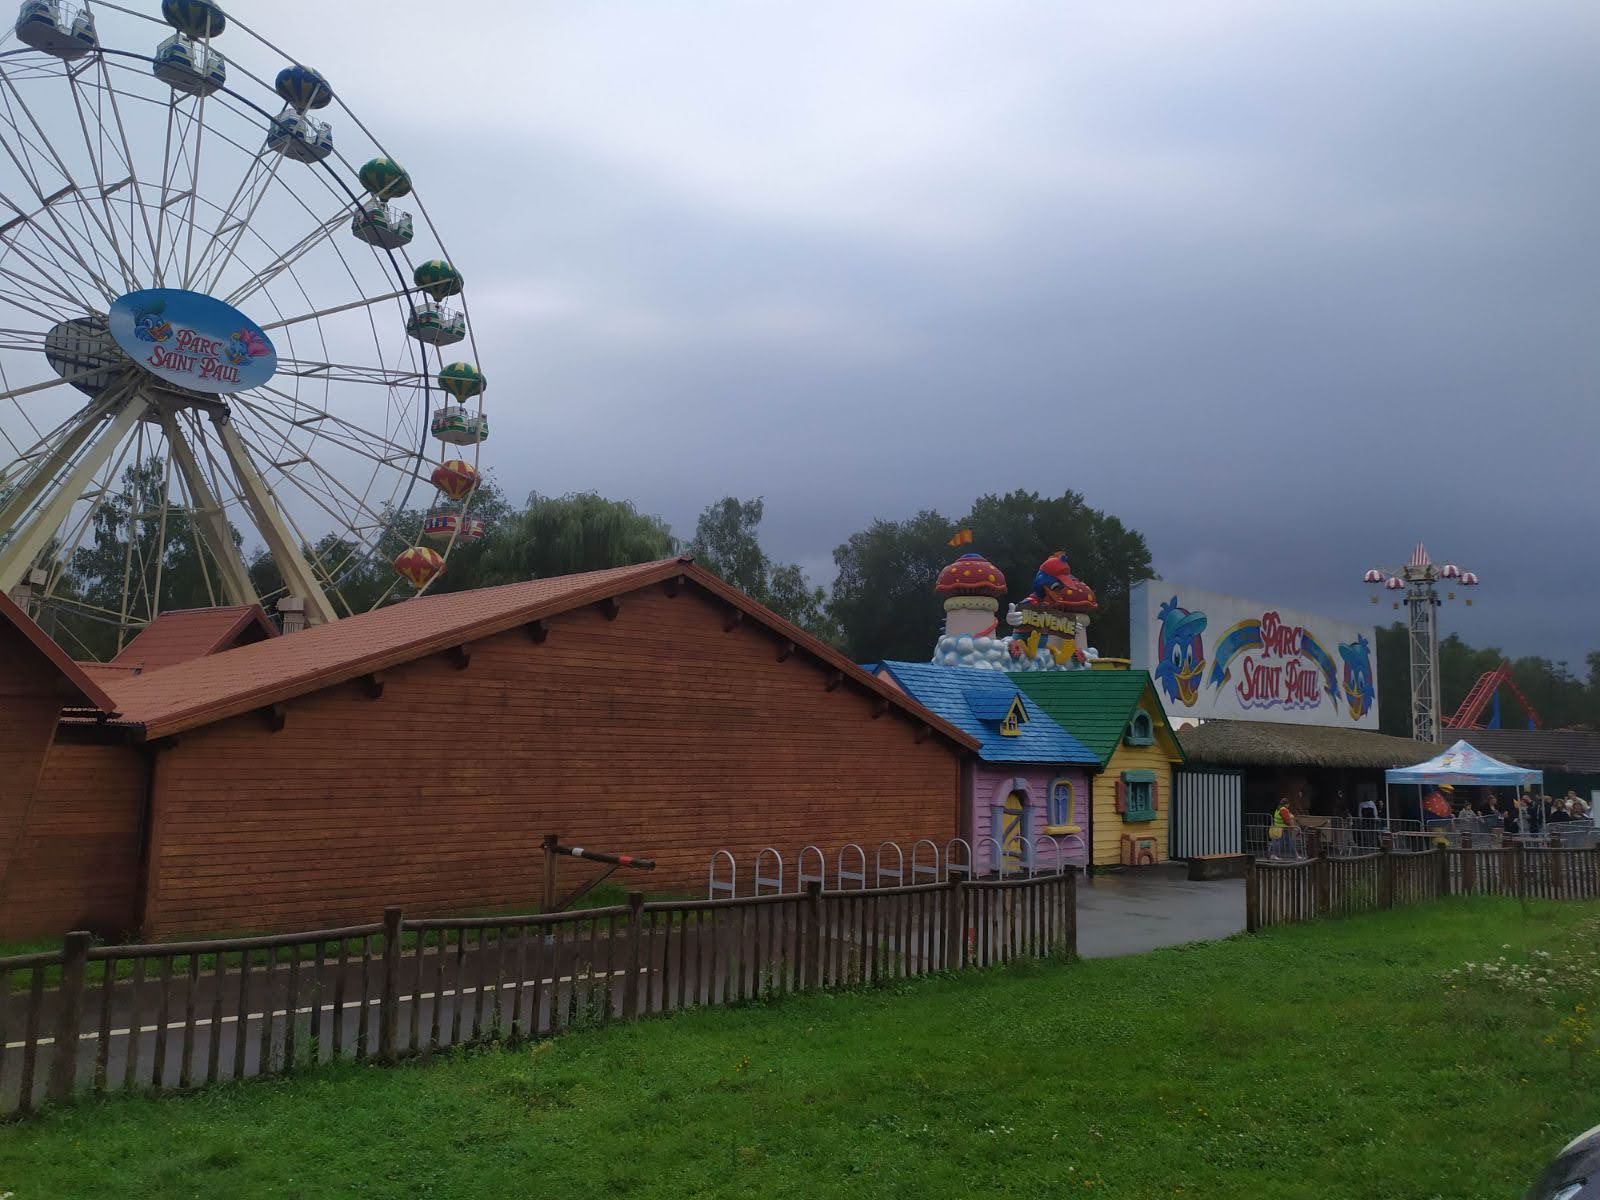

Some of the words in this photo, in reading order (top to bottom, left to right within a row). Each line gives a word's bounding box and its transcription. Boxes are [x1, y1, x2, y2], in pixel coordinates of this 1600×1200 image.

[147, 345, 198, 372] SAINT
[199, 357, 241, 384] PAUL
[175, 329, 223, 357] PARC
[1261, 611, 1303, 658] PARC
[1238, 656, 1282, 701] SAINT
[1284, 659, 1319, 704] PAUL
